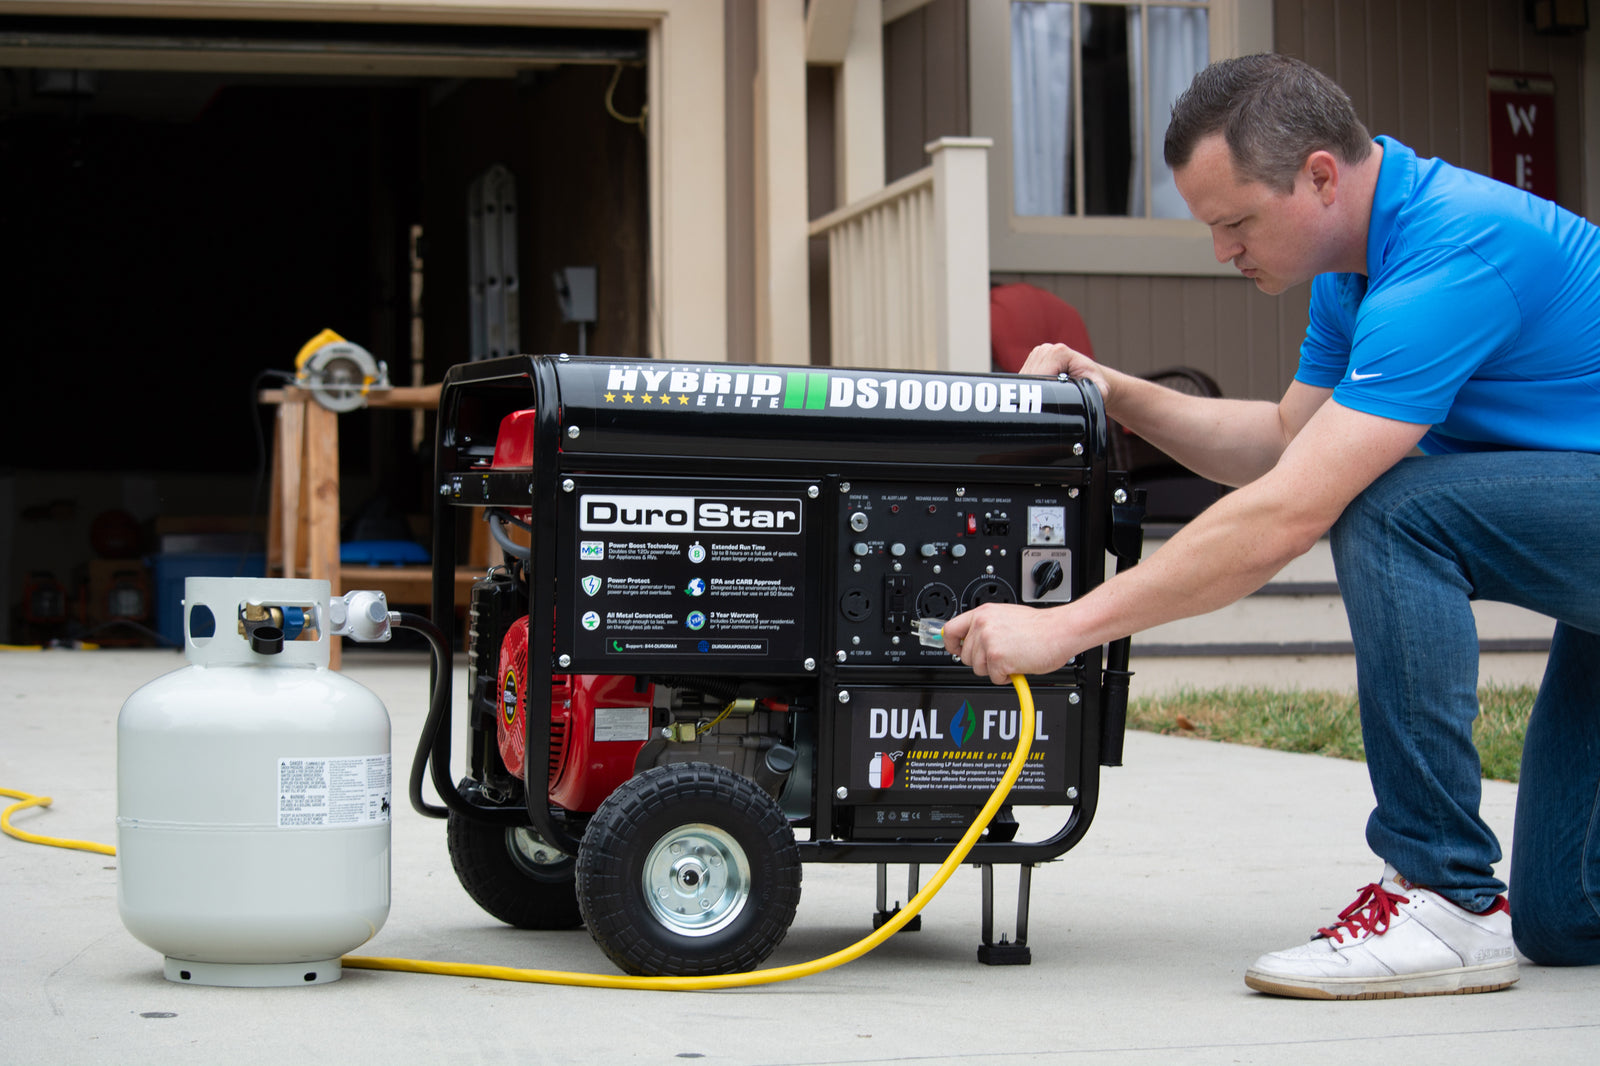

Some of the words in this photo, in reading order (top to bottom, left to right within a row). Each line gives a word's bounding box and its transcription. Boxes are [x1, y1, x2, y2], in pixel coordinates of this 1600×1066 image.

[606, 369, 782, 395] HYBRID
[829, 377, 1043, 414] DS10000EH
[697, 394, 780, 409] ELITE
[586, 501, 688, 526] Duro
[698, 503, 796, 528] Star
[869, 708, 944, 740] DUAL
[982, 709, 1049, 741] FUL
[906, 750, 940, 759] LIQUID
[942, 751, 984, 760] PROPANE
[987, 752, 998, 760] or
[1001, 752, 1046, 760] GAINE
